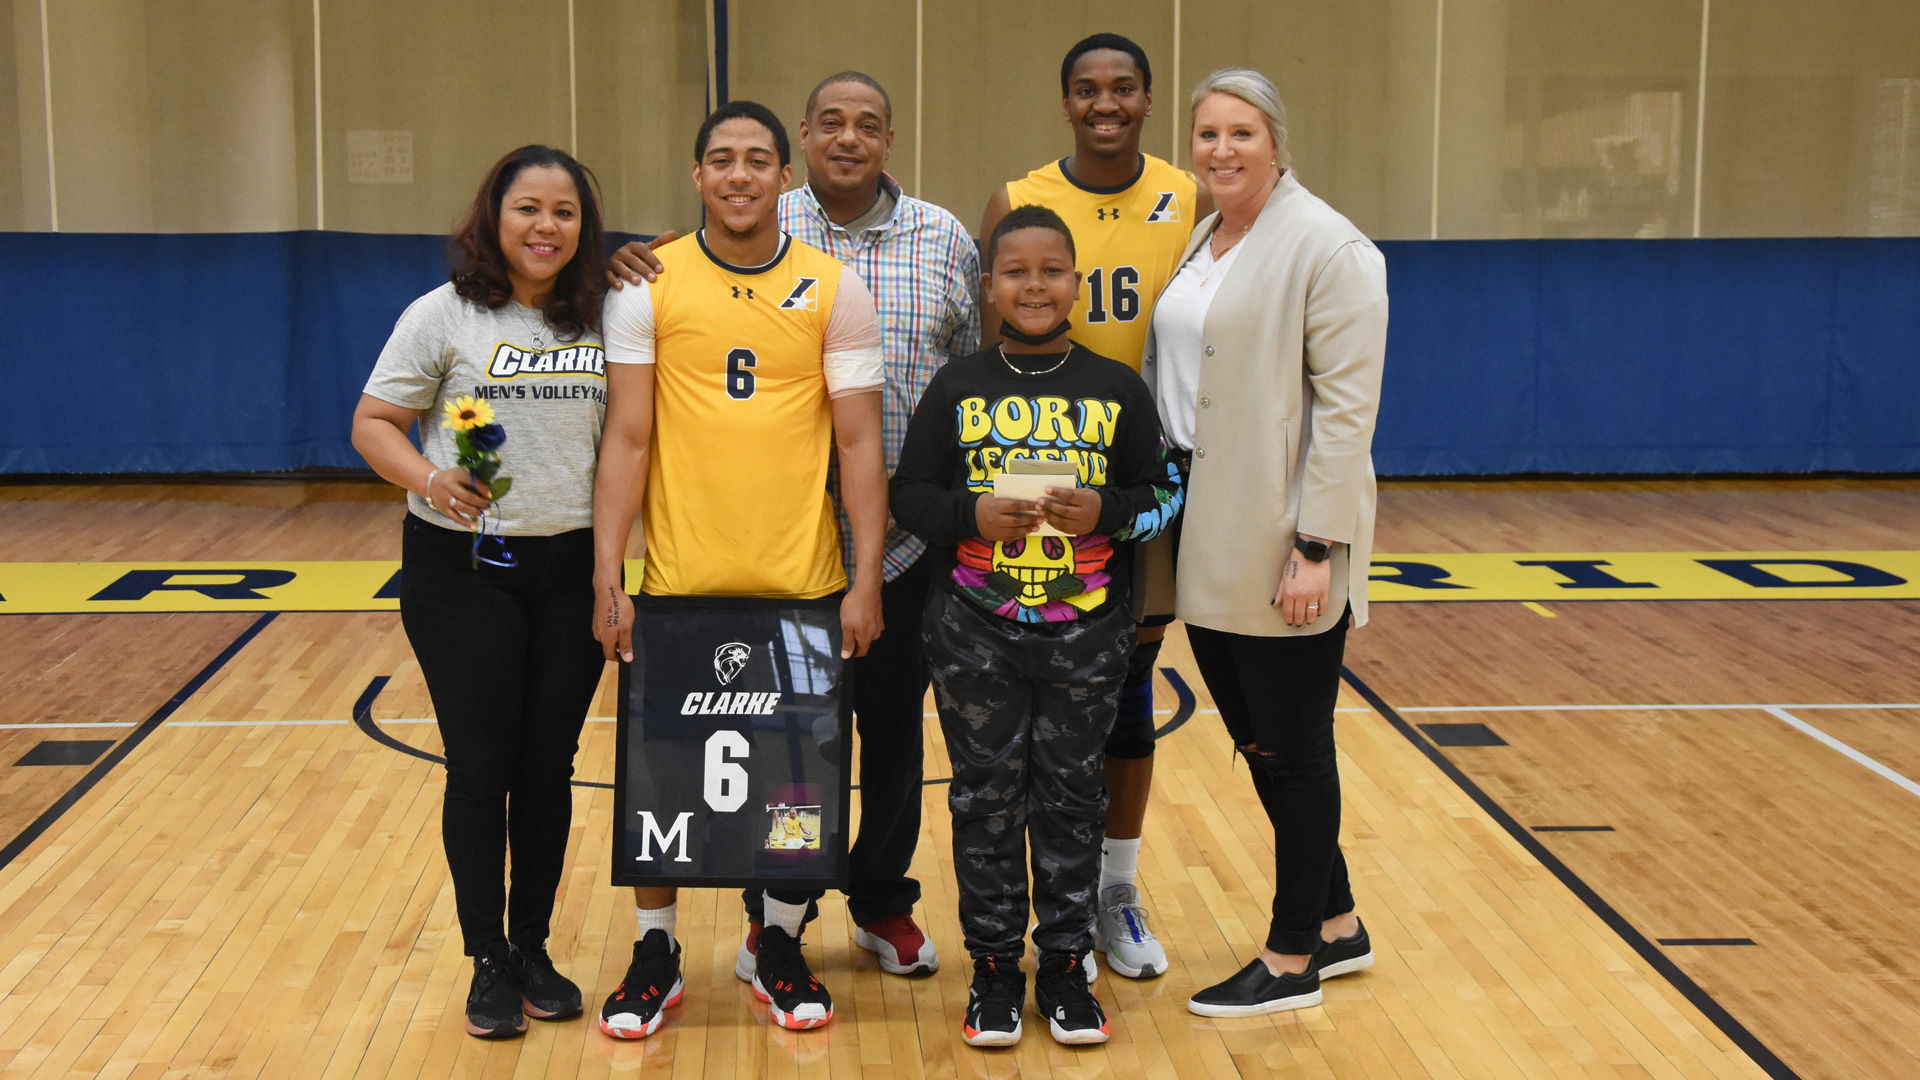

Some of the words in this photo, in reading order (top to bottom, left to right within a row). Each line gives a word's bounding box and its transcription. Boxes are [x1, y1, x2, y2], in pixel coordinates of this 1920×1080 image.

[1086, 265, 1140, 324] 16
[489, 344, 605, 377] CLARKE
[726, 347, 758, 400] 6
[474, 385, 526, 399] MEN'S
[956, 396, 1122, 450] BORN
[680, 692, 782, 715] CLARKE
[703, 730, 750, 813] 6
[635, 810, 694, 863] M
